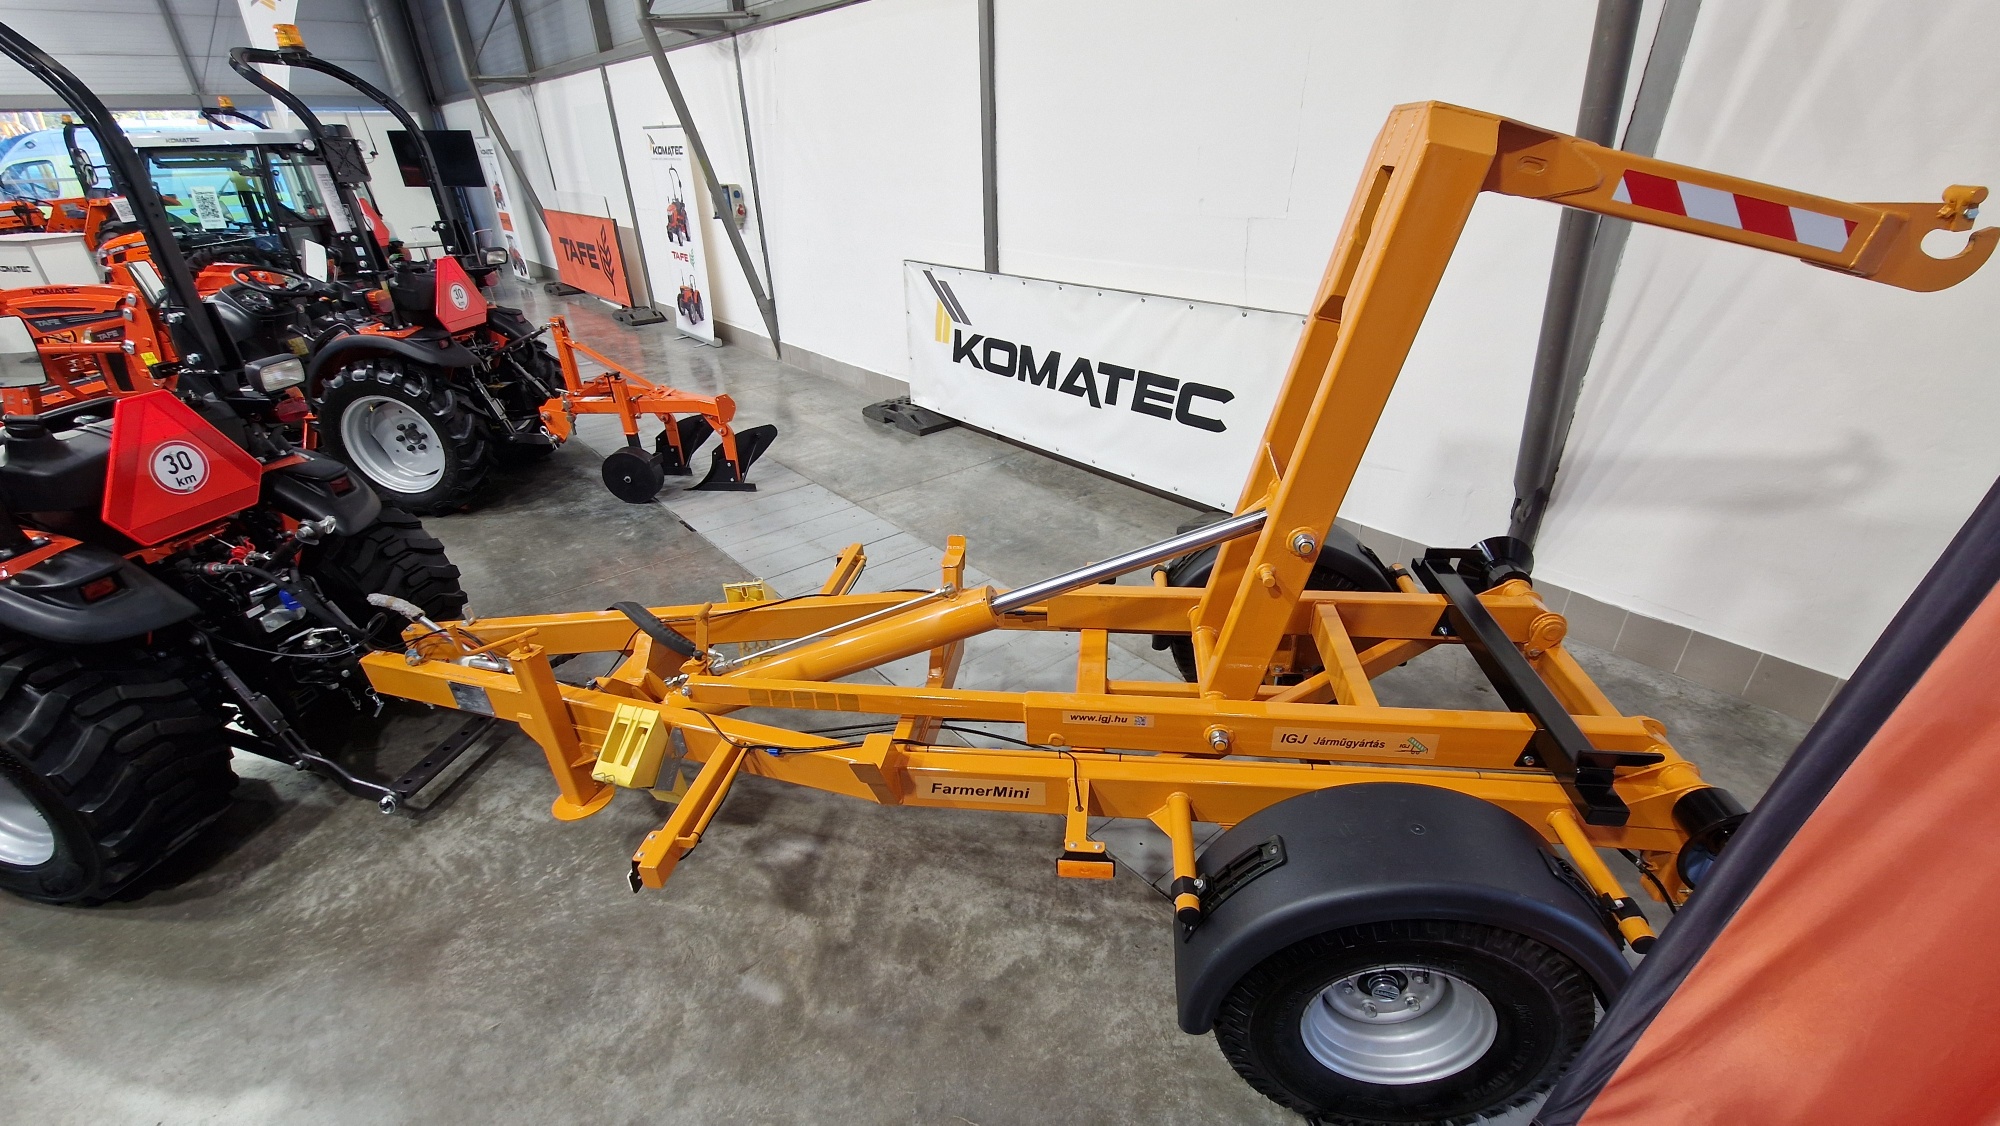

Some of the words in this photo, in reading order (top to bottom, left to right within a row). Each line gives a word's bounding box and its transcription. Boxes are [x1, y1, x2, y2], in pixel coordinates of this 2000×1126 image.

[652, 145, 684, 156] KOMATEC
[558, 236, 600, 270] TAFE
[671, 250, 689, 262] TAFE
[31, 287, 80, 295] KOMATEC
[453, 288, 464, 299] 30
[35, 318, 62, 327] TAFE
[97, 330, 120, 340] TAFE
[952, 328, 1235, 433] KOMATEC
[162, 450, 193, 475] 30
[175, 474, 197, 487] km
[1069, 714, 1128, 724] www.igj.hu
[1280, 733, 1309, 744] IGJ
[931, 782, 1030, 799] FarmerMini
